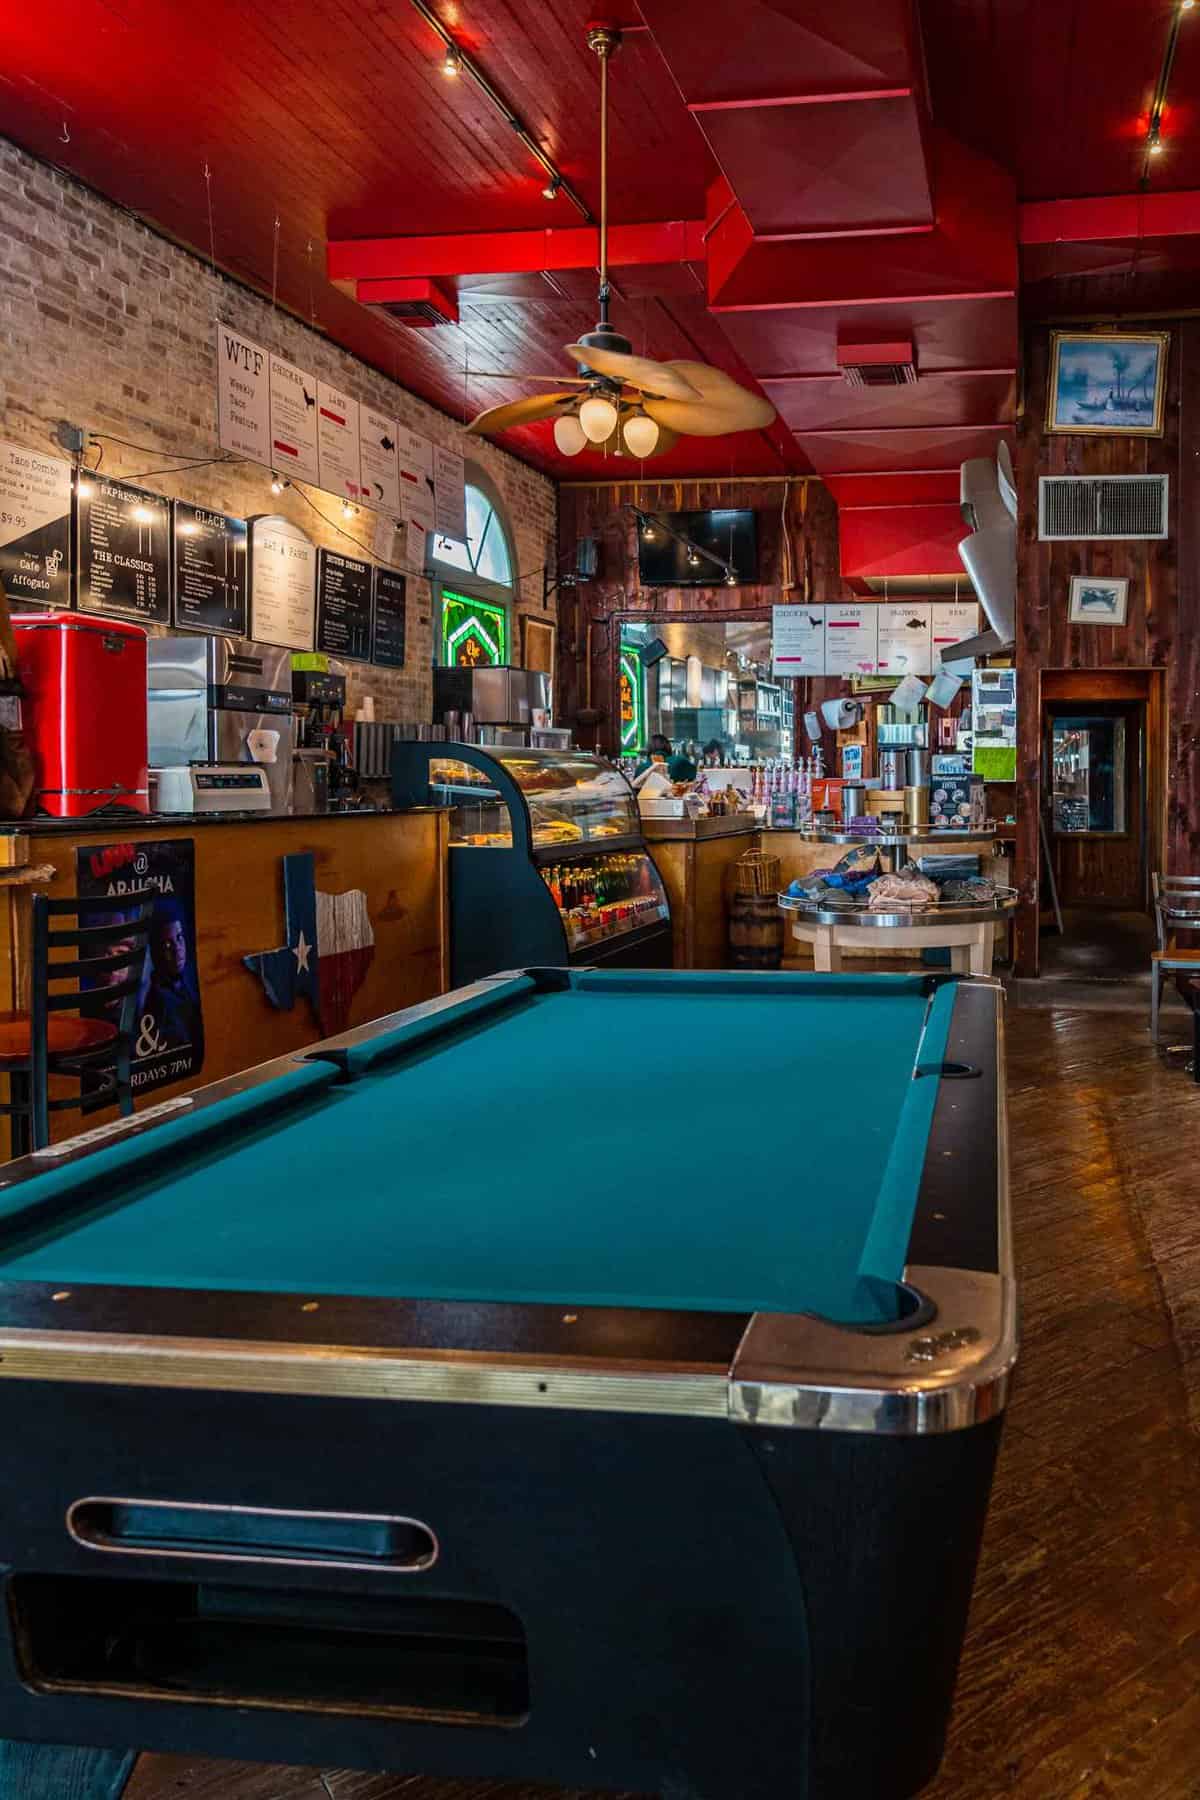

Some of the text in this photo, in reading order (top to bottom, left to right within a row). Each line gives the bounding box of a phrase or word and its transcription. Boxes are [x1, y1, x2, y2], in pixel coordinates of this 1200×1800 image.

[224, 335, 264, 376] WTF
[20, 559, 40, 572] Cafe
[93, 549, 154, 573] THE CLASSICS
[12, 574, 50, 590] Affogato
[133, 852, 149, 875] @
[136, 1014, 168, 1057] &
[169, 1057, 192, 1073] 7PM
